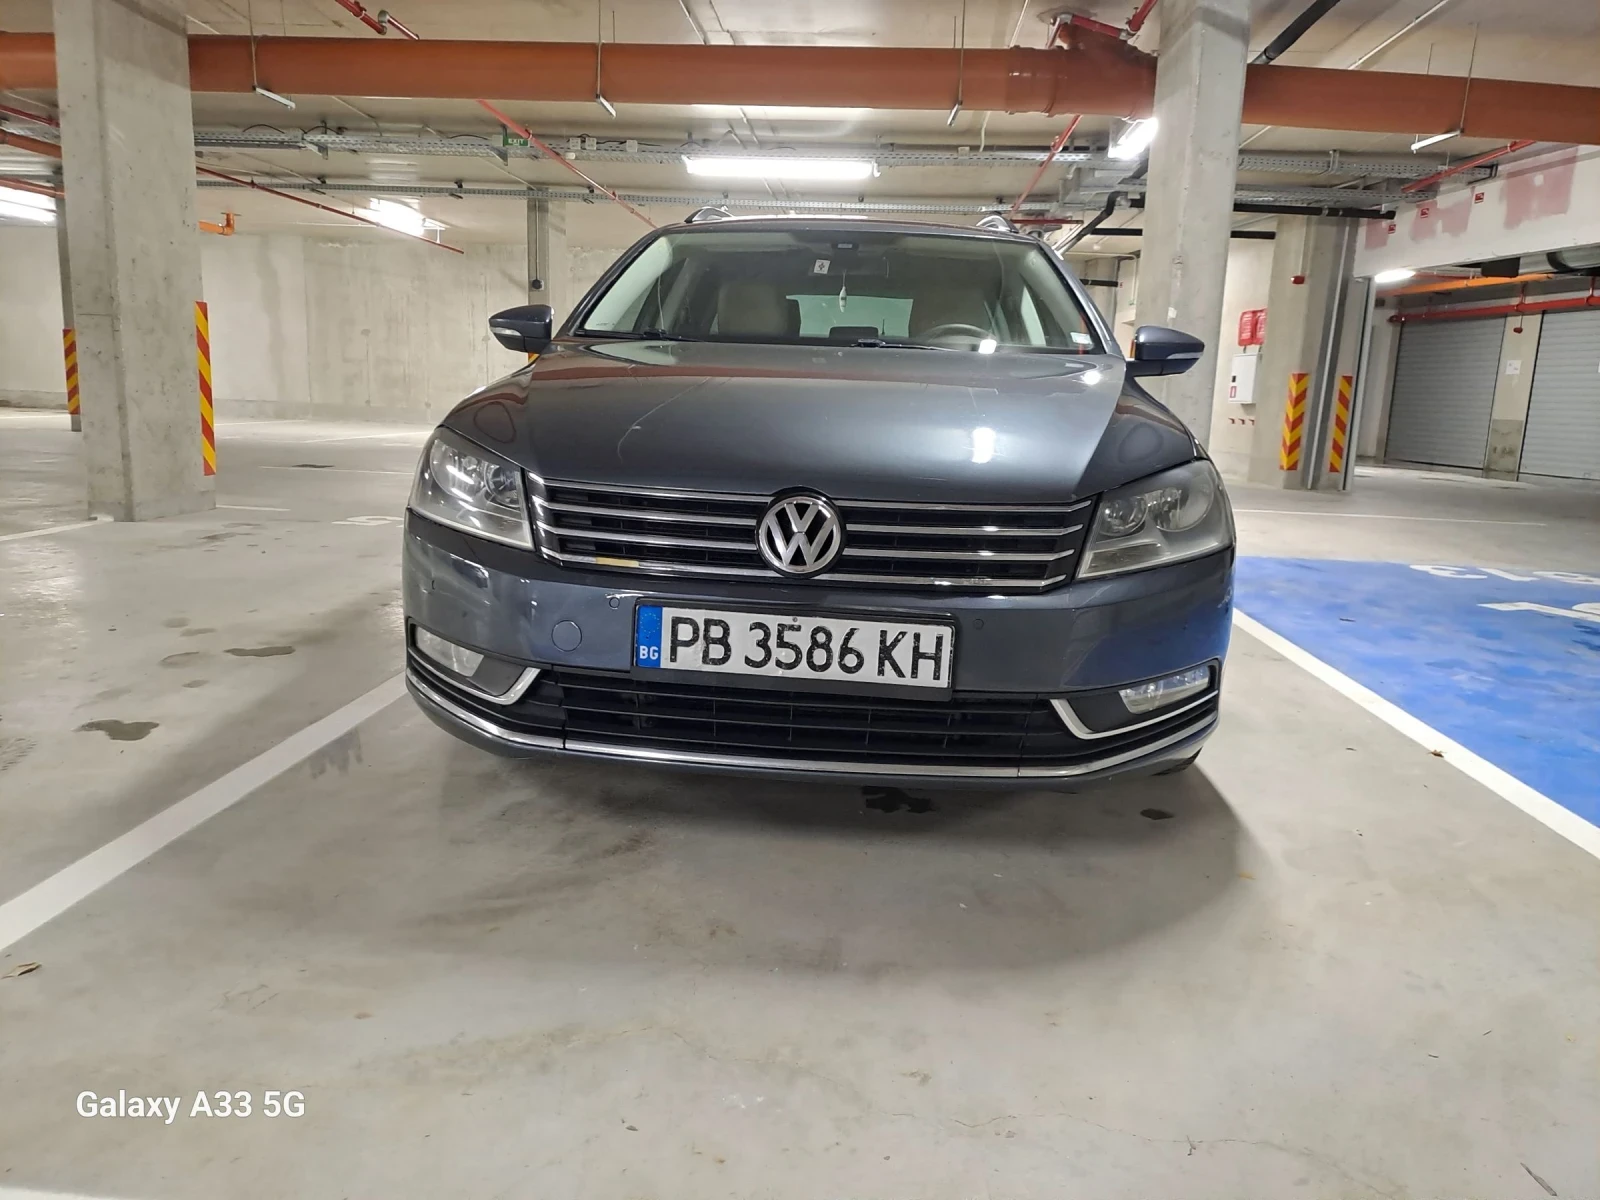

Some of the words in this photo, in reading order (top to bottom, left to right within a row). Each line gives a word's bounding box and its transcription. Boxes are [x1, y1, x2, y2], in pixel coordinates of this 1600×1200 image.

[639, 645, 659, 660] BG
[669, 615, 731, 666] PB
[744, 622, 865, 674] 3586
[877, 629, 944, 681] KH
